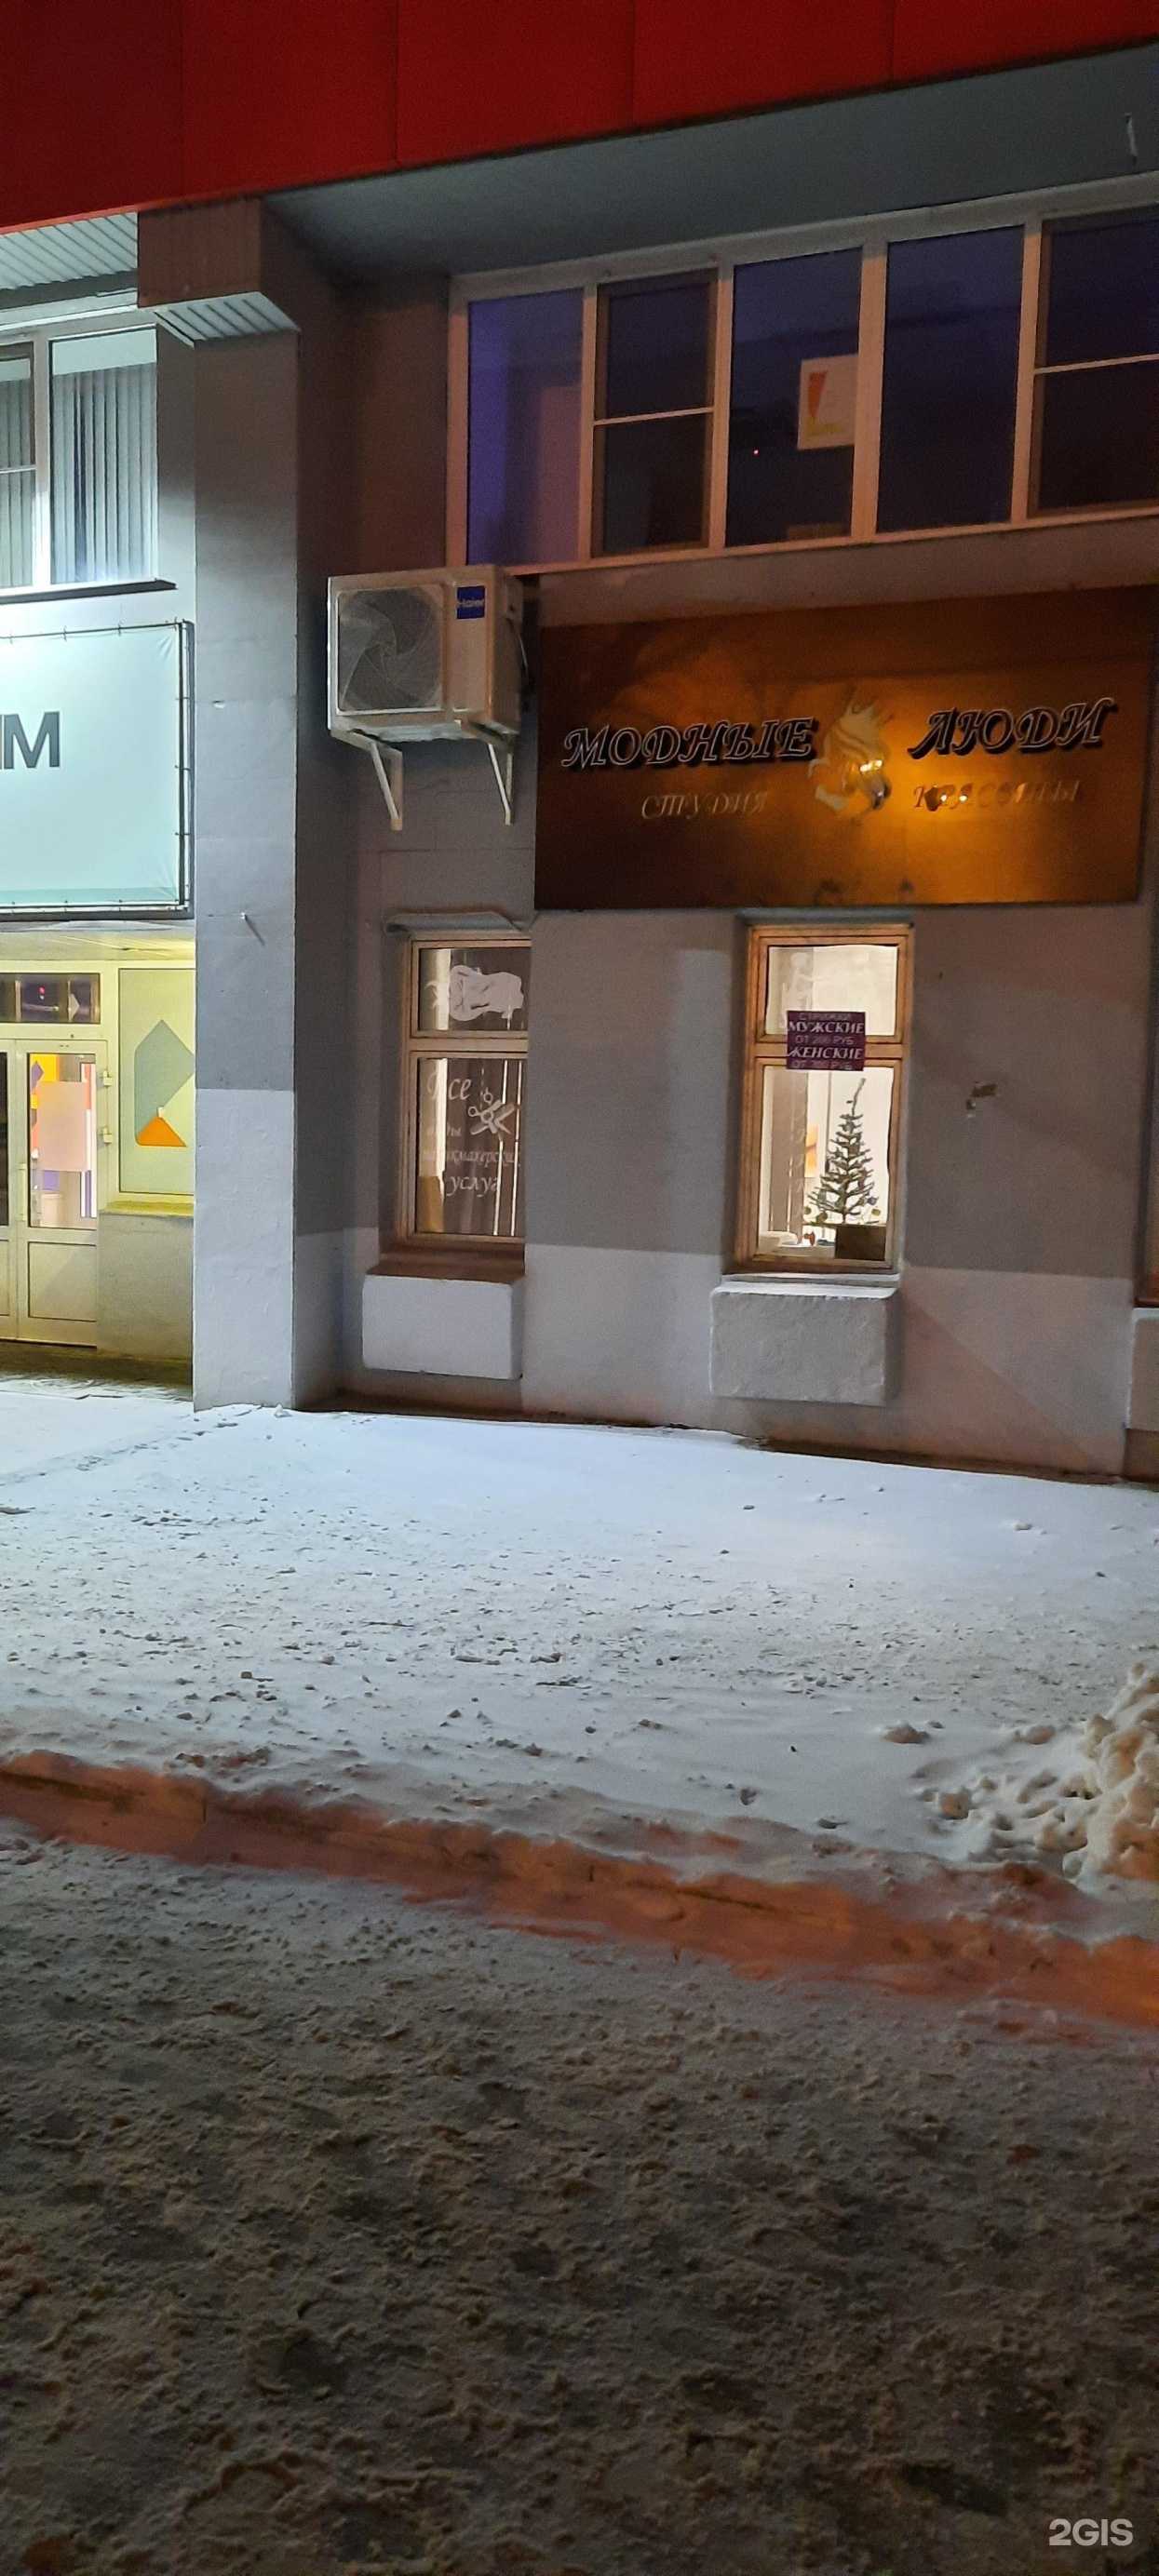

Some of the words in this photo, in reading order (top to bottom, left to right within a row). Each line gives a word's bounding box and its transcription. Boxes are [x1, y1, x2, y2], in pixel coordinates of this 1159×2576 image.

[0, 710, 61, 770] М
[561, 718, 818, 770] МОДНЫЕ
[908, 698, 1117, 758] ЛЮДИ
[641, 792, 768, 819] СТУДИЯ
[788, 1021, 865, 1034] МУЖСКИЕ
[795, 1035, 809, 1044] ОТ
[788, 1046, 864, 1059] ЖЕНСКИЕ
